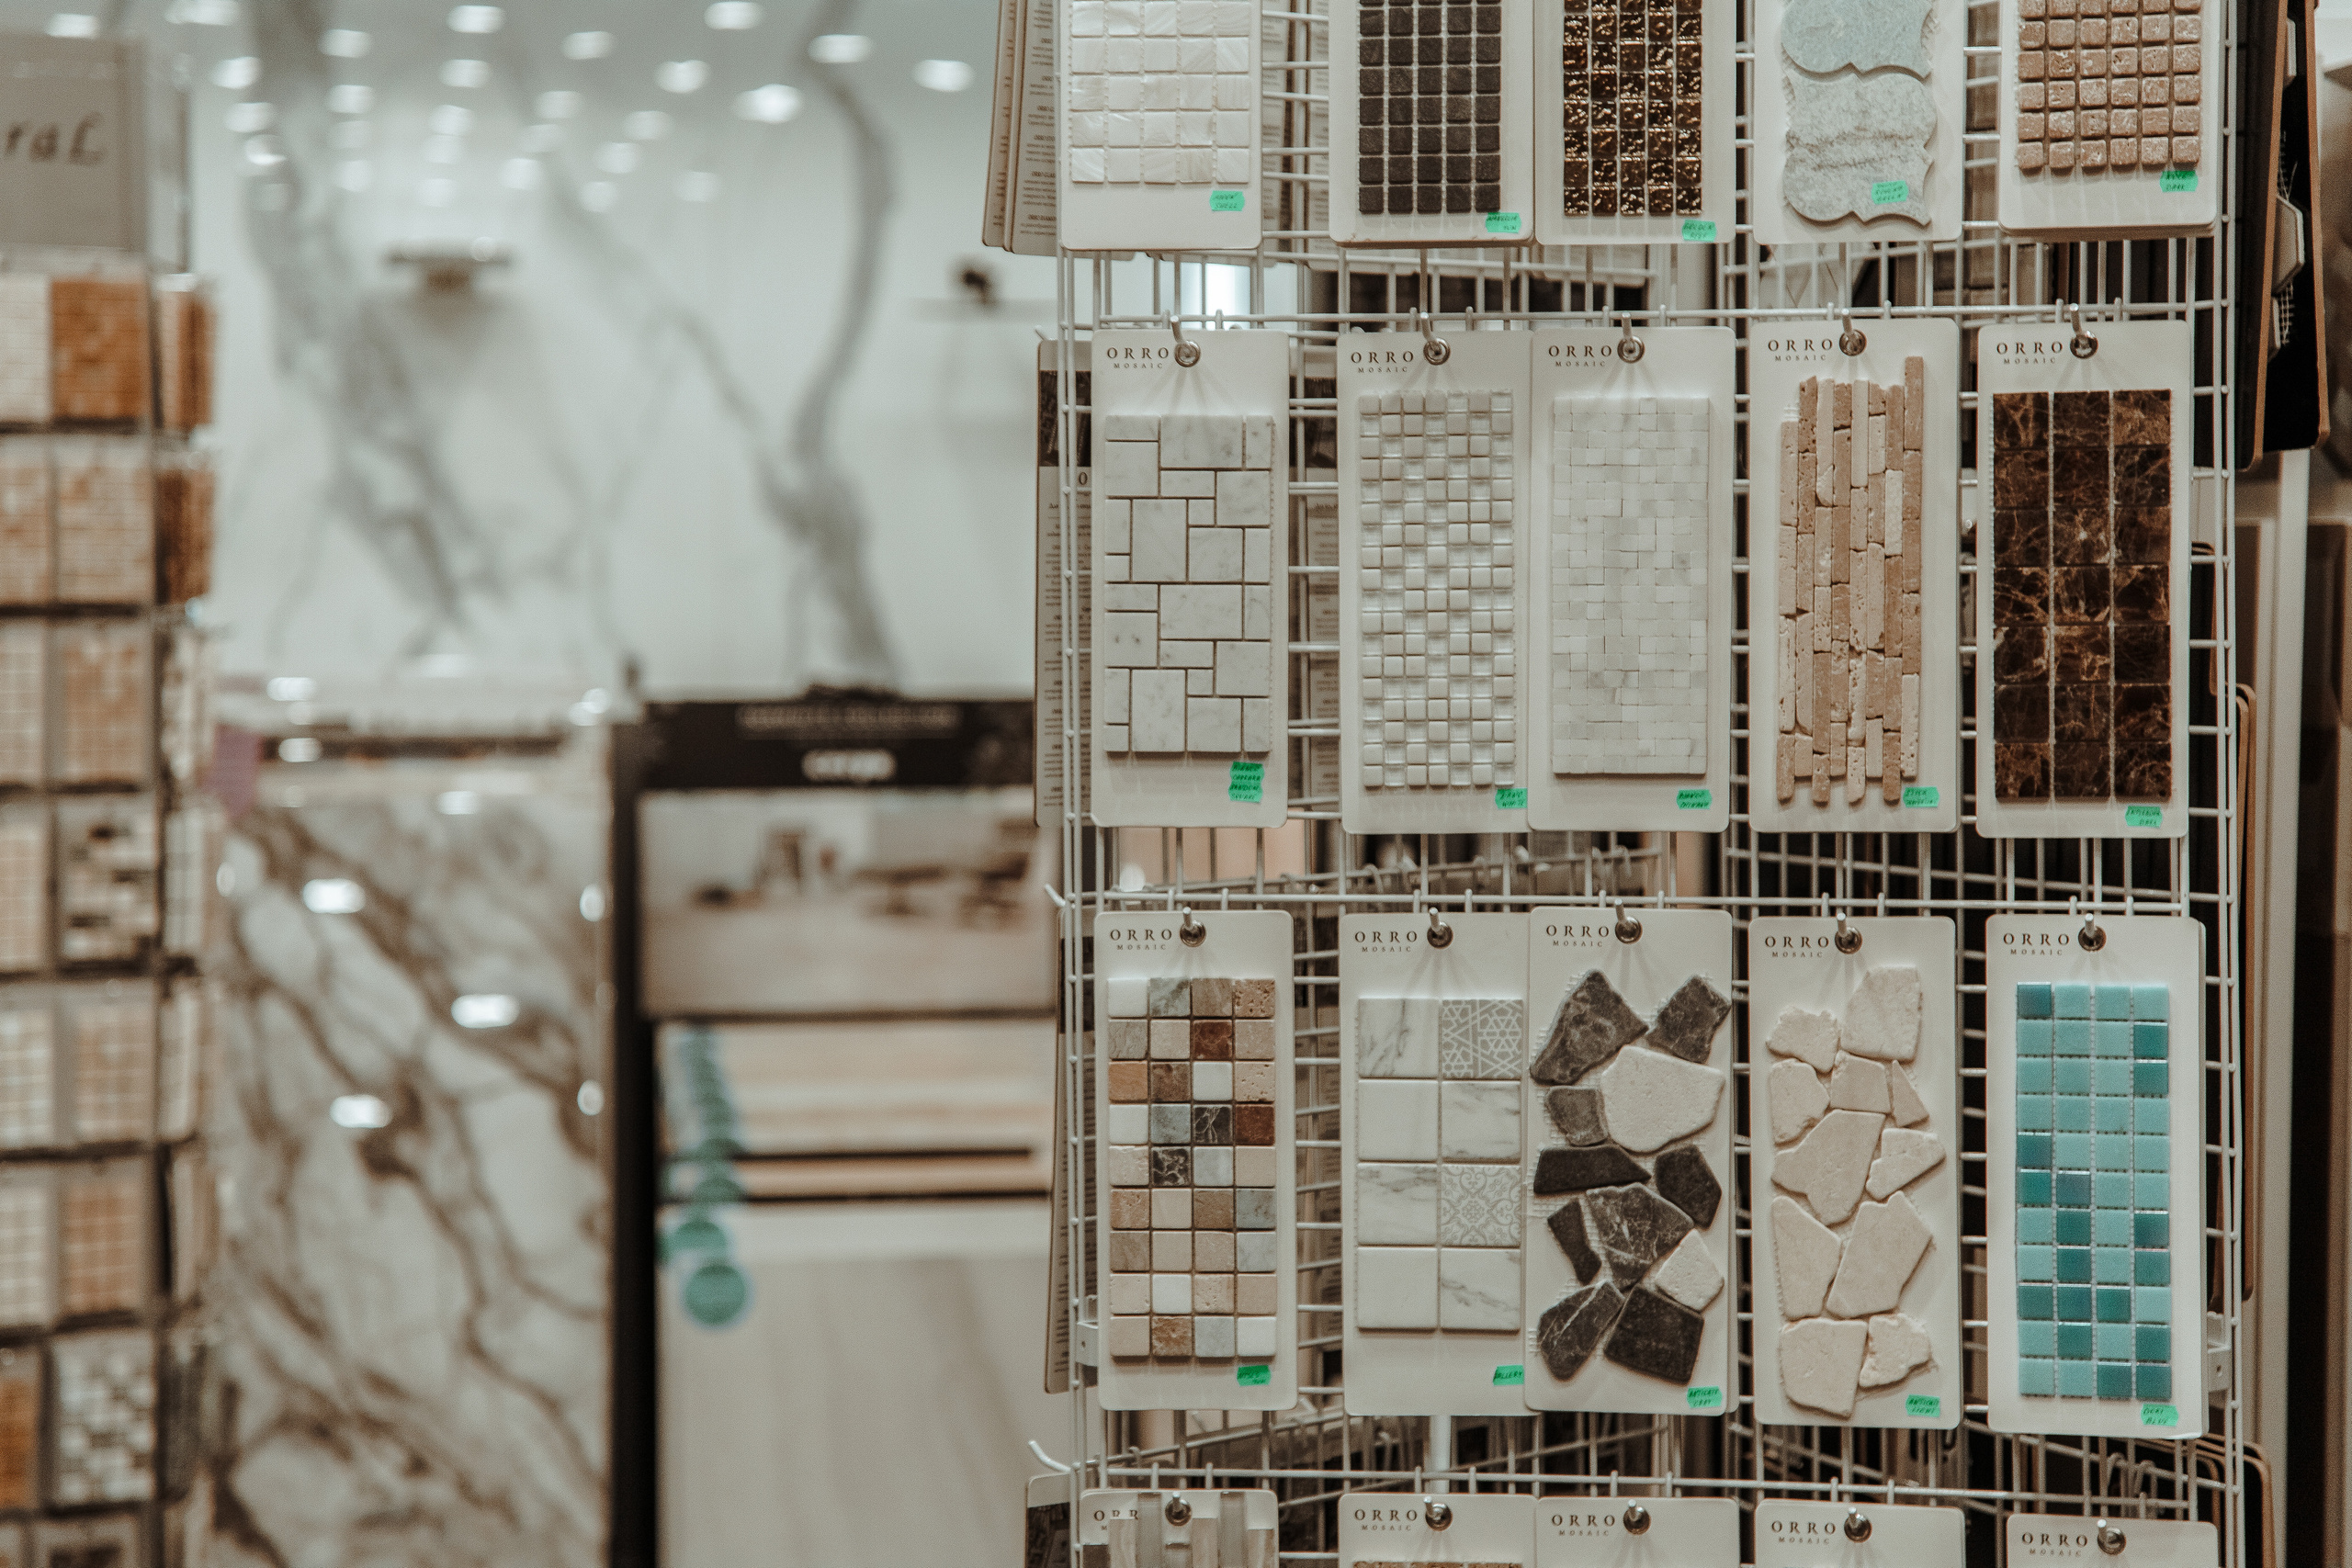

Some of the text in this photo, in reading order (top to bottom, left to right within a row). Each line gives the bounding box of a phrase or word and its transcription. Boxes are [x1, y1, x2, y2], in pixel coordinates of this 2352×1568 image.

[1548, 345, 1612, 357] ORRO
[1768, 338, 1833, 352] ORRO
[1996, 341, 2063, 355] ORRO
[1107, 347, 1169, 360] ORRO
[1351, 351, 1414, 364] ORRO
[2003, 356, 2056, 365] MOSAIC
[1110, 929, 1172, 942] ORRO
[1354, 931, 1418, 943] ORRO
[1546, 924, 1609, 938] ORRO
[1765, 936, 1829, 949] ORRO
[2003, 932, 2070, 946] ORRO
[1093, 1509, 1139, 1522] ORR
[1354, 1509, 1418, 1522] ORRO
[1552, 1514, 1615, 1527] ORRO
[1771, 1520, 1836, 1535] ORRO
[1778, 1537, 1830, 1545] MOSAIC
[2021, 1531, 2088, 1548] ORRO
[2029, 1548, 2081, 1557] MOSAIC
